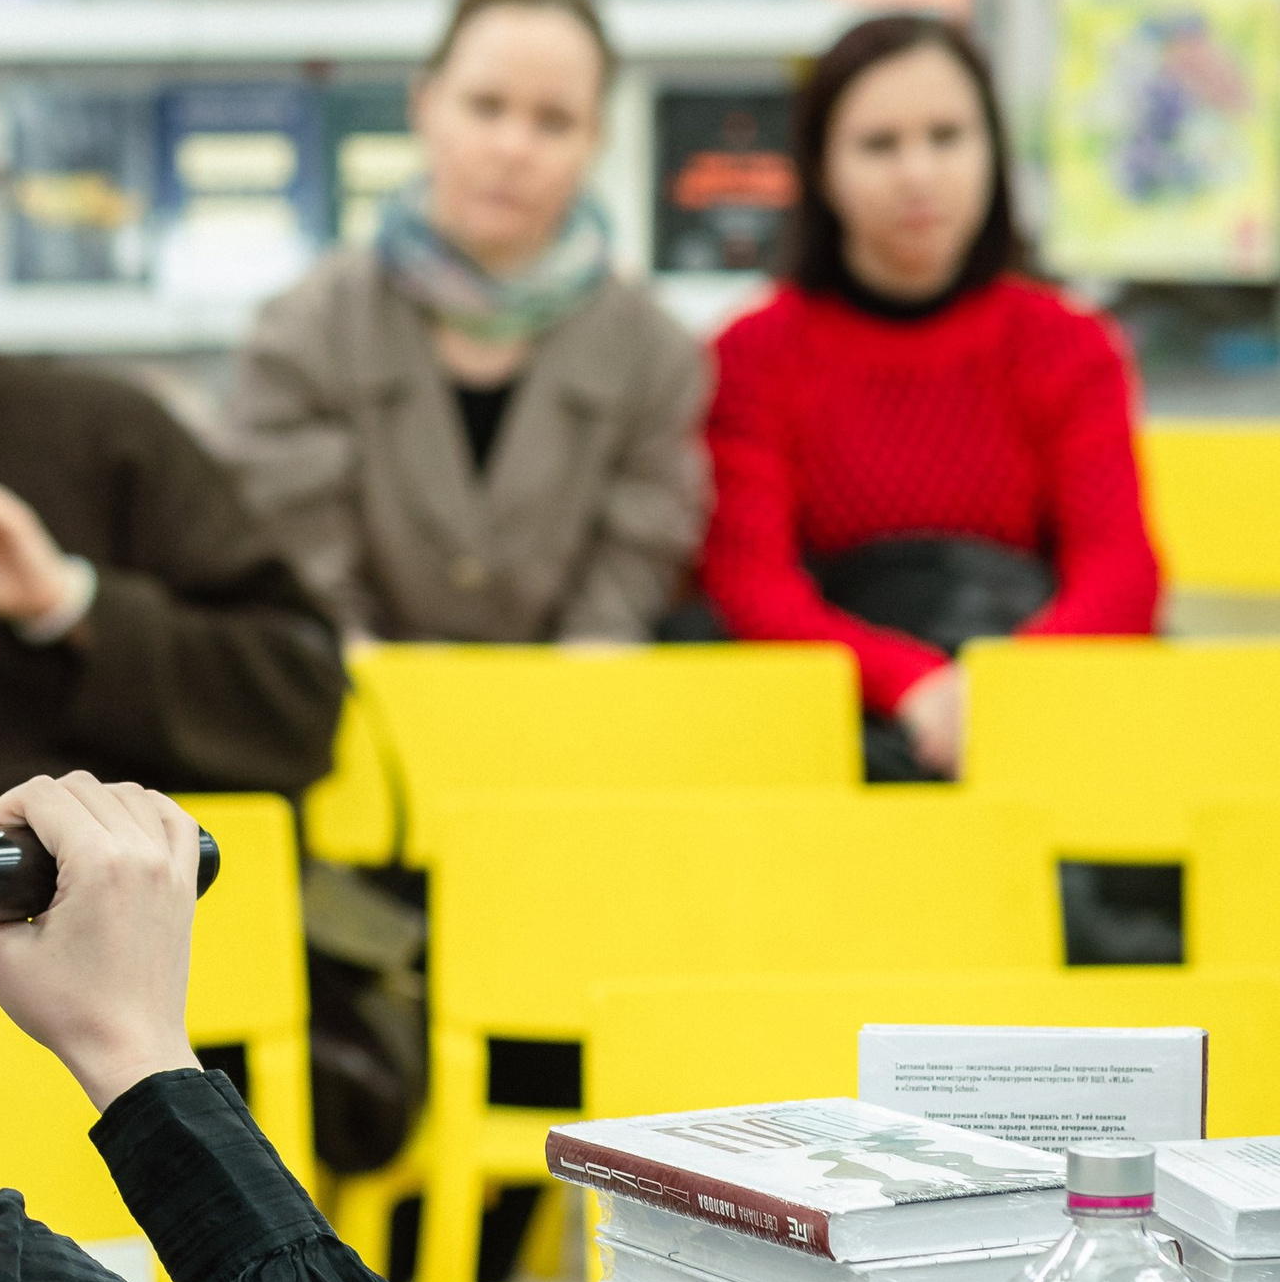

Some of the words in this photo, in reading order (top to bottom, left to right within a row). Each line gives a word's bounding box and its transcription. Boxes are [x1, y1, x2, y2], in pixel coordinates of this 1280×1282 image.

[895, 1062, 925, 1070] Светлана
[926, 1063, 954, 1071] Павлова
[1053, 1064, 1070, 1072] Дома
[1072, 1065, 1108, 1073] творчества
[931, 1084, 953, 1093] Writing
[924, 1111, 951, 1120] Героине
[980, 1112, 1008, 1120] «Голод»
[1010, 1112, 1026, 1120] Лене
[1028, 1113, 1059, 1121] тридцать
[560, 1156, 690, 1204] ГОЛОД
[698, 1193, 736, 1219] ПАВЛОВА
[738, 1205, 779, 1232] СВЕТЛАНА
